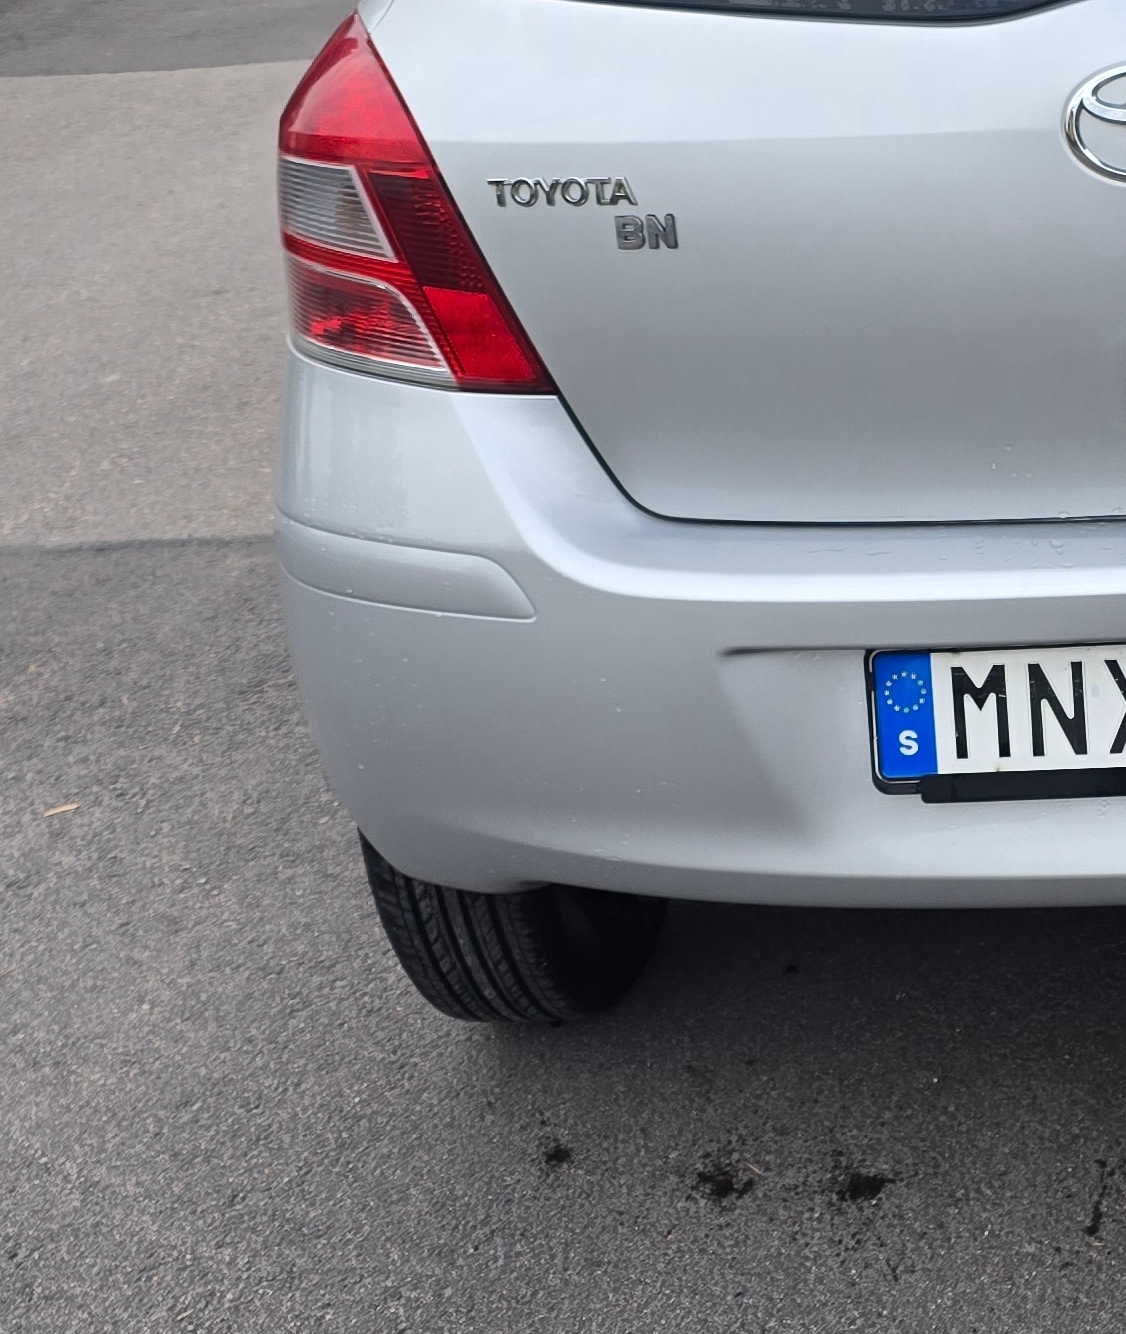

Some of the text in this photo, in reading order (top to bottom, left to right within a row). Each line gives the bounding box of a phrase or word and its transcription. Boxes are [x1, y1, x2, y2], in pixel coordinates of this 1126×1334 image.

[486, 176, 639, 208] TOYOTA
[614, 213, 679, 250] BN
[898, 729, 919, 756] S
